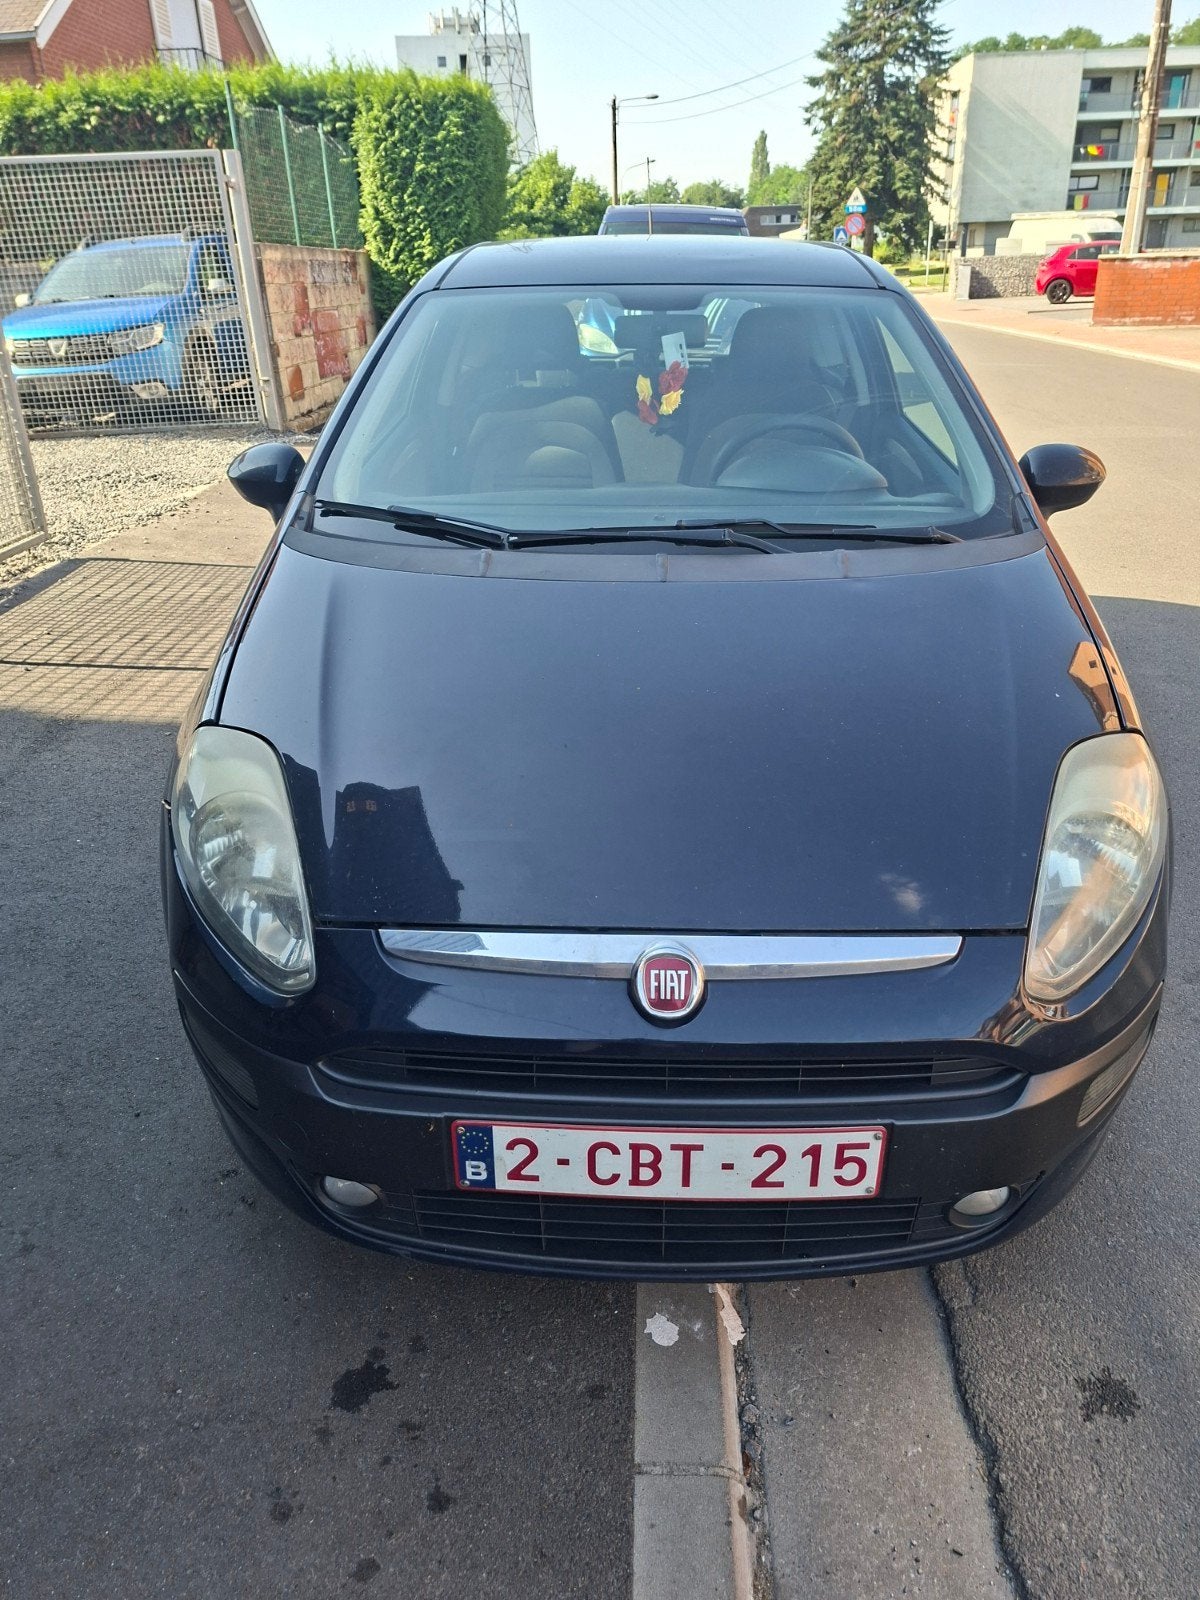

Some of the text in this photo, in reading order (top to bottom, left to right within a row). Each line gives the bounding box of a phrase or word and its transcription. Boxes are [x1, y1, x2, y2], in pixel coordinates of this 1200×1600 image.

[650, 969, 688, 1000] FIAT
[465, 1160, 487, 1180] B
[505, 1137, 870, 1188] 2-CBT-215
